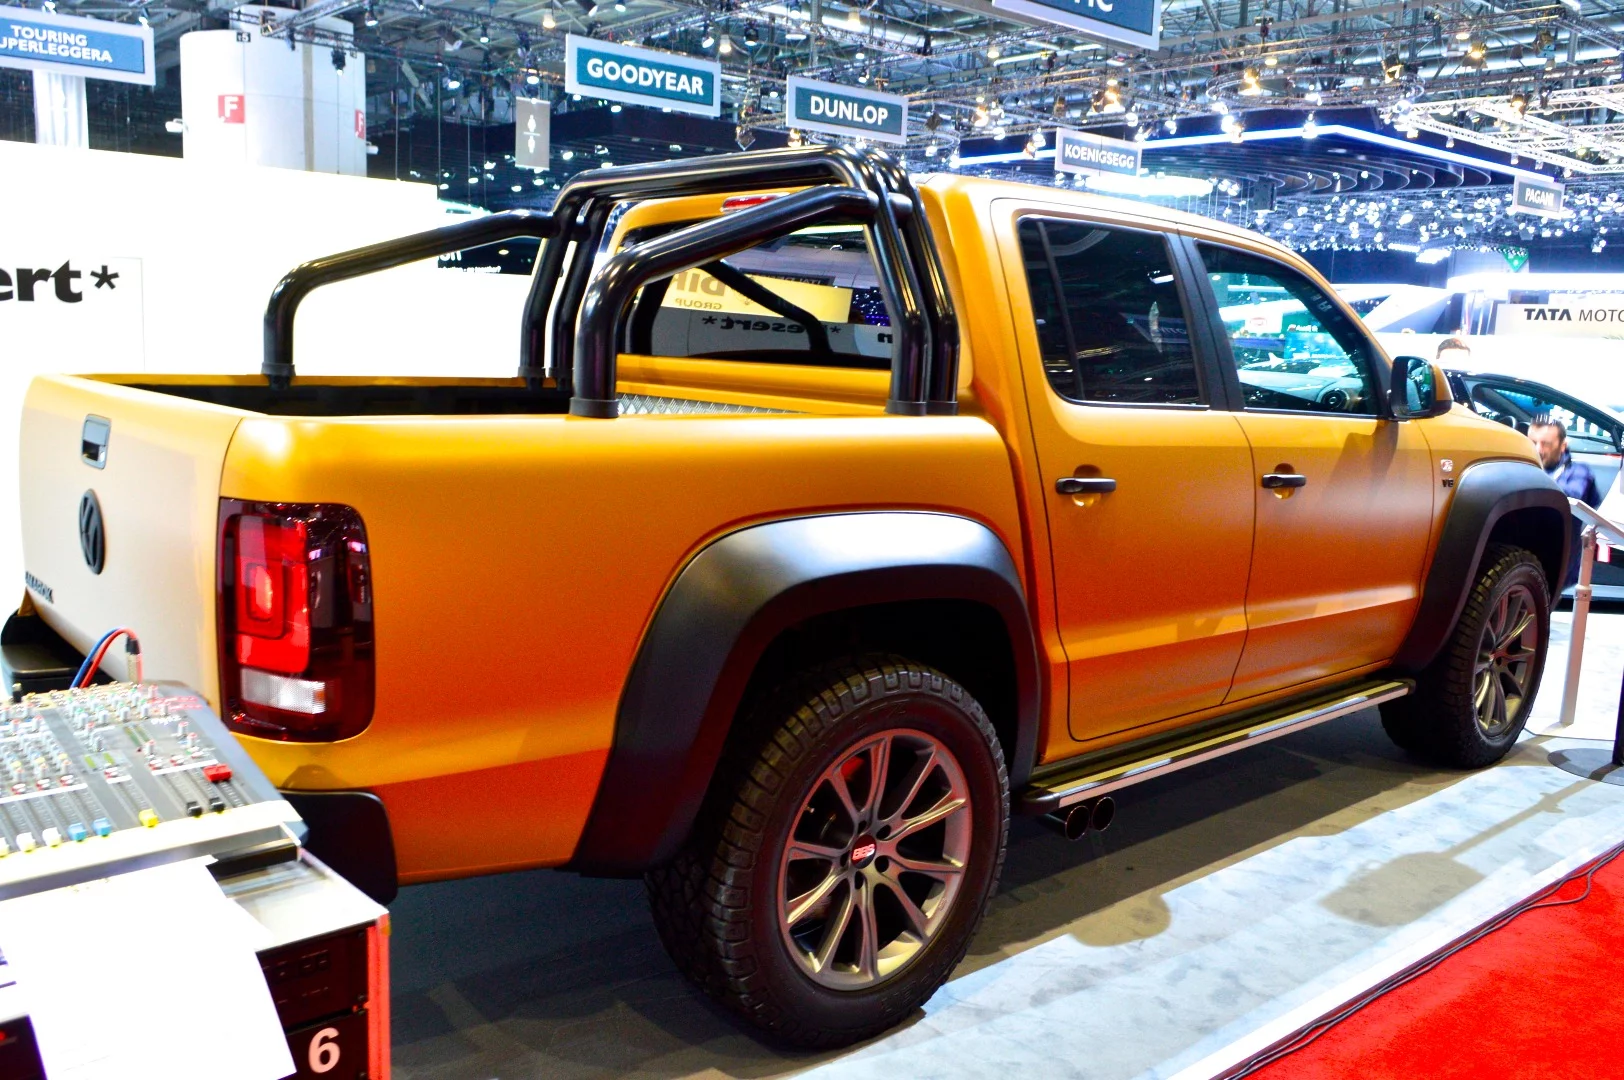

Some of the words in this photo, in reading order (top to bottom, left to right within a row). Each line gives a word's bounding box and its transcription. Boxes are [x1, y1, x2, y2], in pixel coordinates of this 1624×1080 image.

[10, 24, 88, 47] TOURING
[587, 58, 704, 95] GOODYEAR
[224, 96, 239, 118] F
[810, 95, 888, 126] DUNLOP
[1064, 143, 1135, 169] KOENIGSEGG
[1525, 187, 1555, 207] PAGANI
[1524, 308, 1572, 321] TATA
[851, 843, 876, 861] BBS
[308, 1027, 341, 1074] 6
